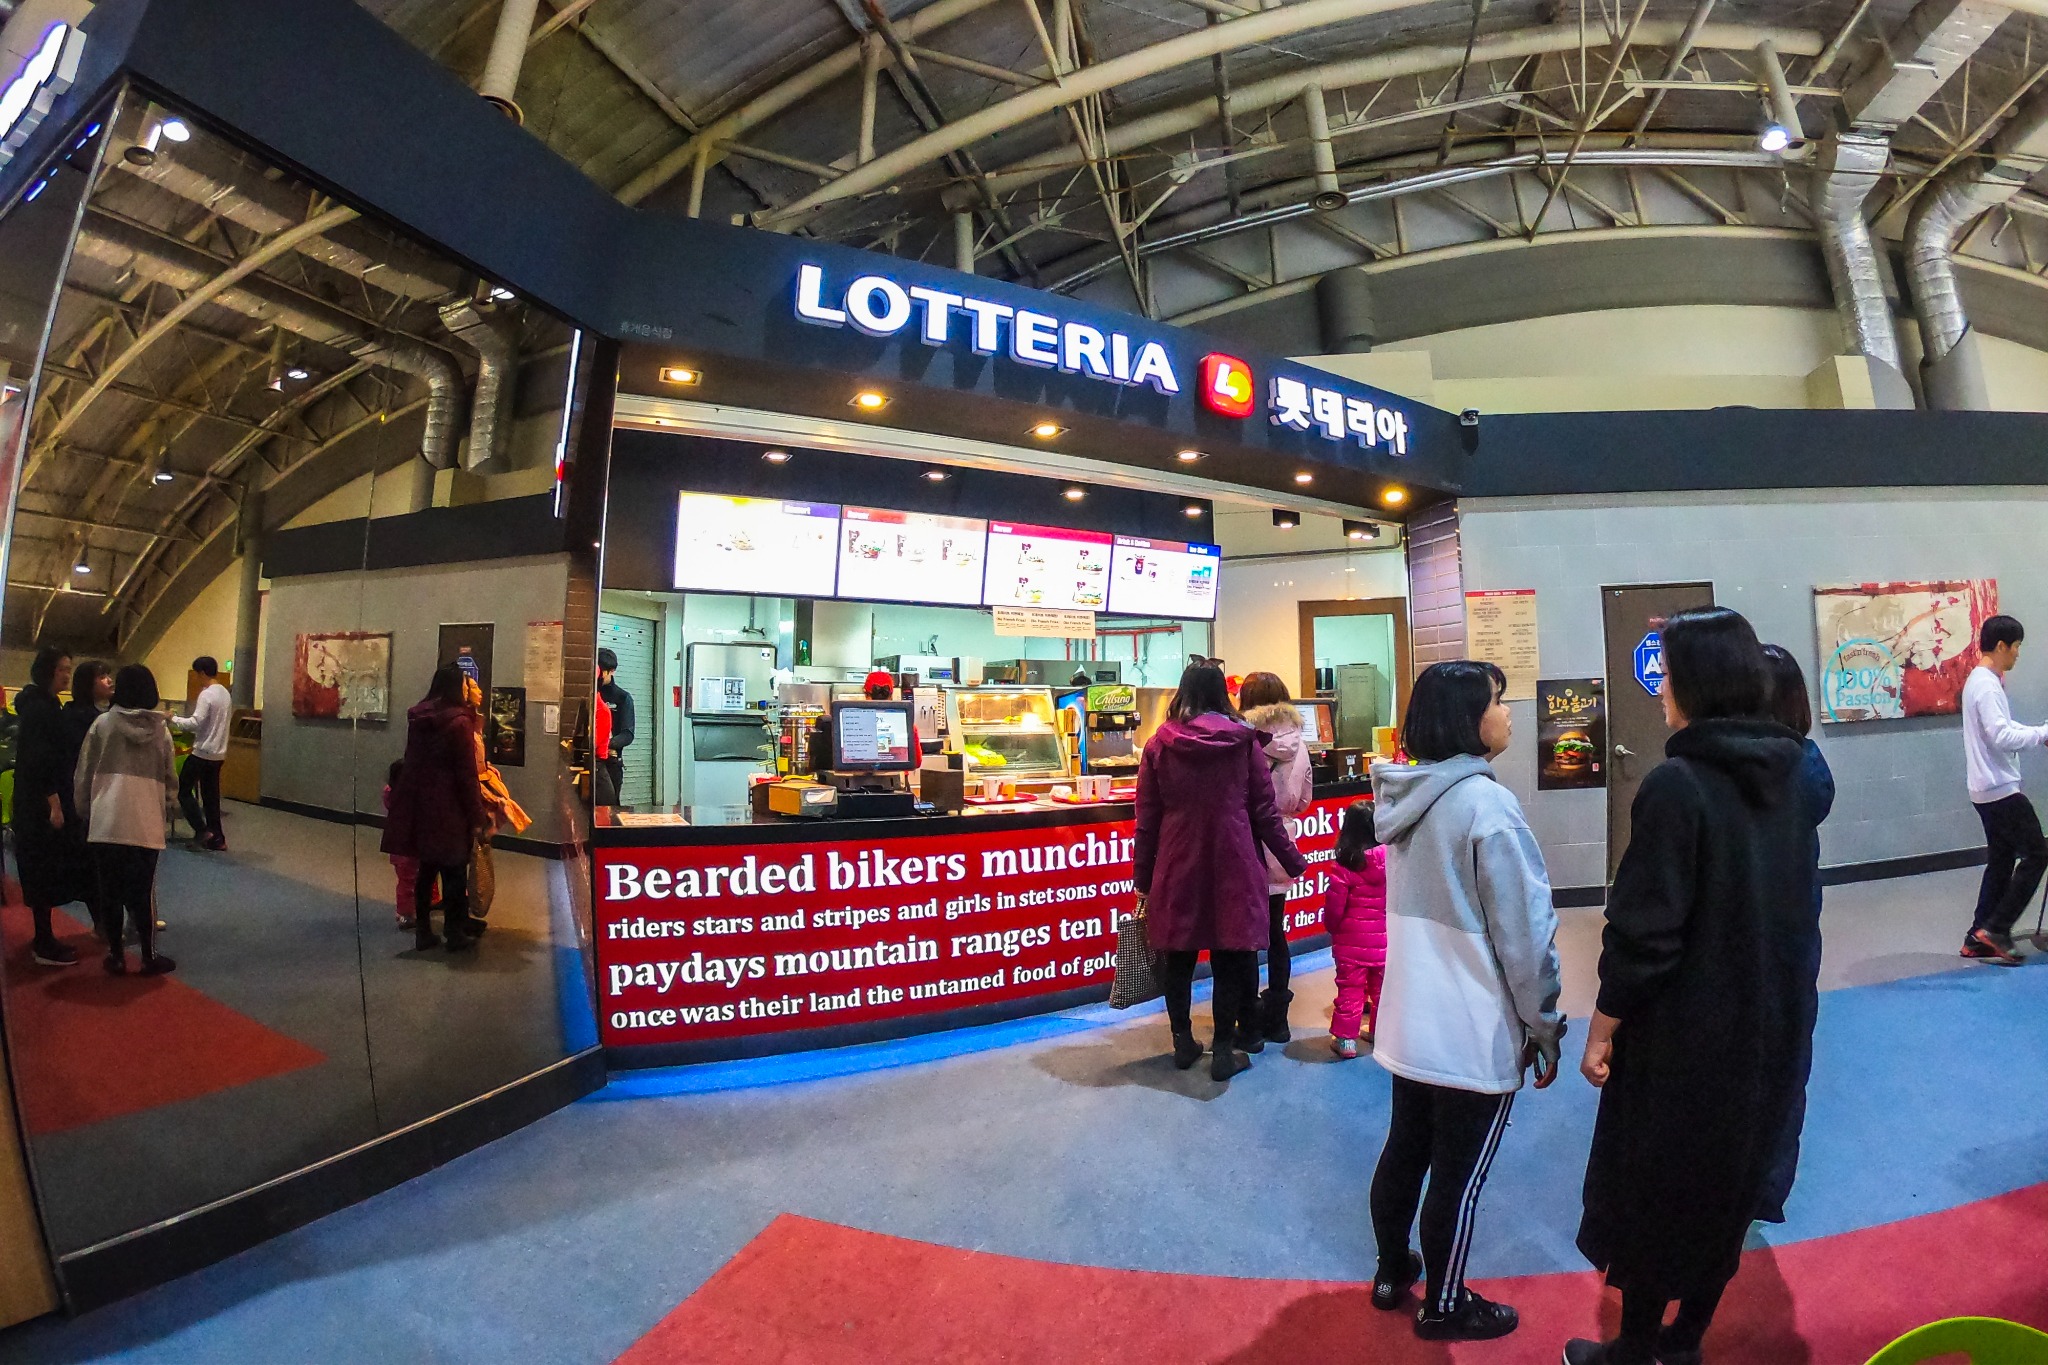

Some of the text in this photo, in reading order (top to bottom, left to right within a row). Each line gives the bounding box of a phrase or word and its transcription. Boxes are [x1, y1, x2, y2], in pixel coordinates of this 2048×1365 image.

[797, 264, 1180, 396] LOTTERIA
[1270, 376, 1408, 455] 롯데리아
[1645, 651, 1662, 674] A
[1835, 666, 1891, 691] 100%
[1836, 691, 1891, 707] Passion
[605, 854, 816, 900] Bearded
[827, 849, 966, 890] bikers
[608, 917, 685, 939] riders
[693, 916, 753, 935] stars
[761, 909, 805, 931] and
[812, 906, 890, 929] stripes
[898, 898, 937, 920] and
[945, 894, 990, 920] girls
[997, 892, 1016, 910] in
[609, 952, 765, 995] paydays
[774, 935, 938, 976] mountain
[951, 925, 1051, 958] ranges
[1059, 916, 1102, 941] ten
[611, 1008, 676, 1029] once
[680, 1004, 735, 1024] was
[738, 995, 803, 1019] their
[809, 988, 861, 1012] land
[867, 985, 903, 1005] the
[909, 969, 1005, 1000] untamed
[1013, 961, 1056, 985] food
[1061, 957, 1081, 976] of
[1295, 910, 1315, 927] the
